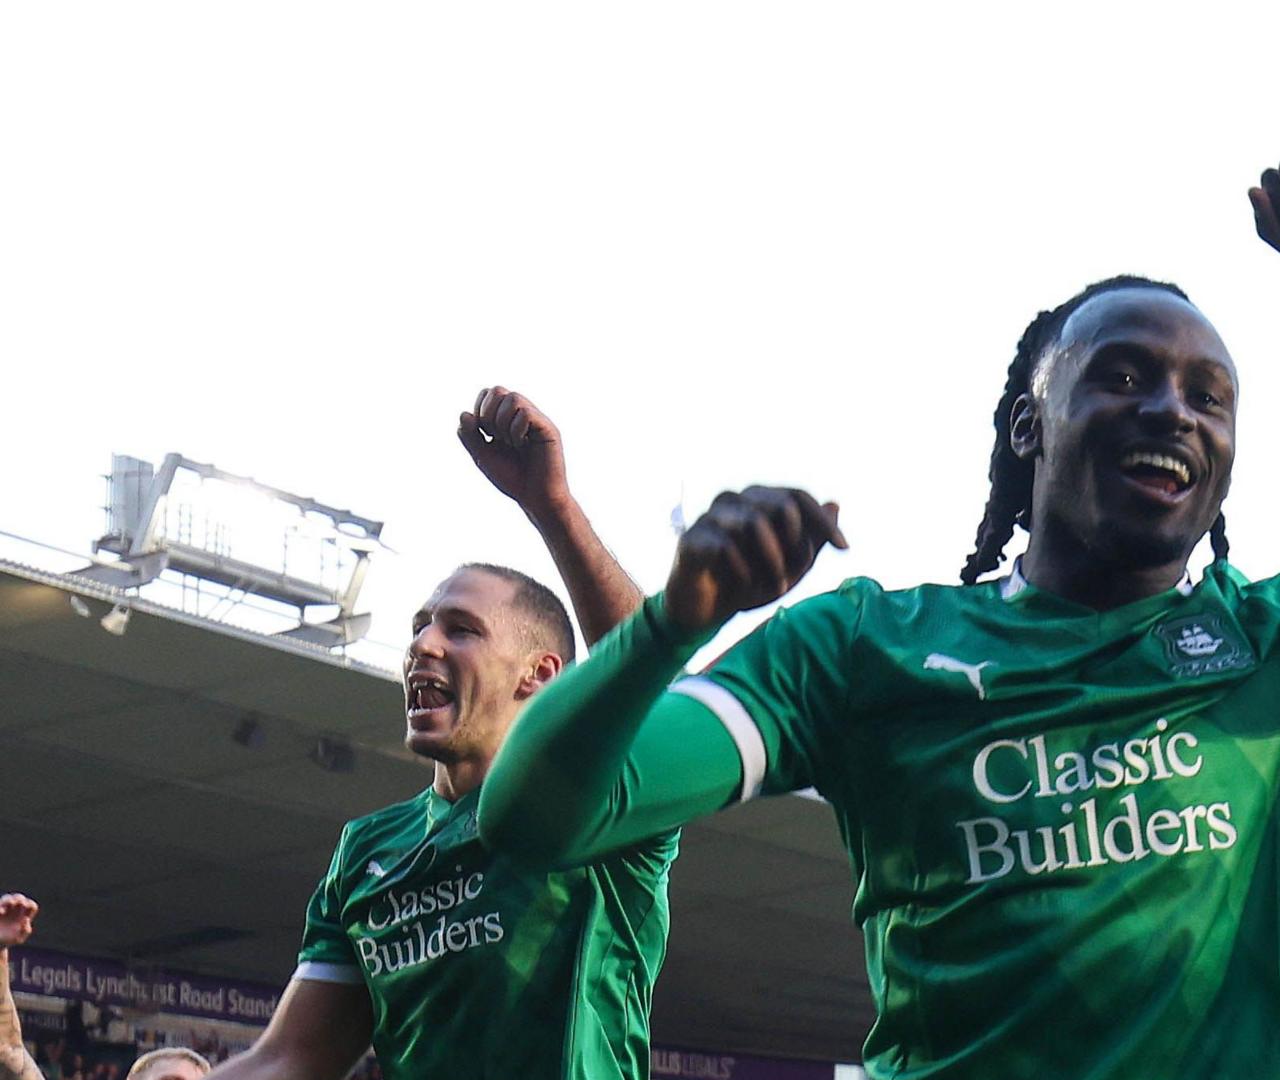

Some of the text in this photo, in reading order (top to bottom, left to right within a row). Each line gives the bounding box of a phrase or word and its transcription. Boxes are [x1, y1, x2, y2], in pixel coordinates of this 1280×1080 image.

[972, 718, 1203, 803] Classic
[956, 793, 1238, 885] Builders
[366, 864, 484, 931] Classic
[356, 911, 505, 979] Builders
[21, 957, 81, 995] Legals
[180, 981, 223, 1012] Road
